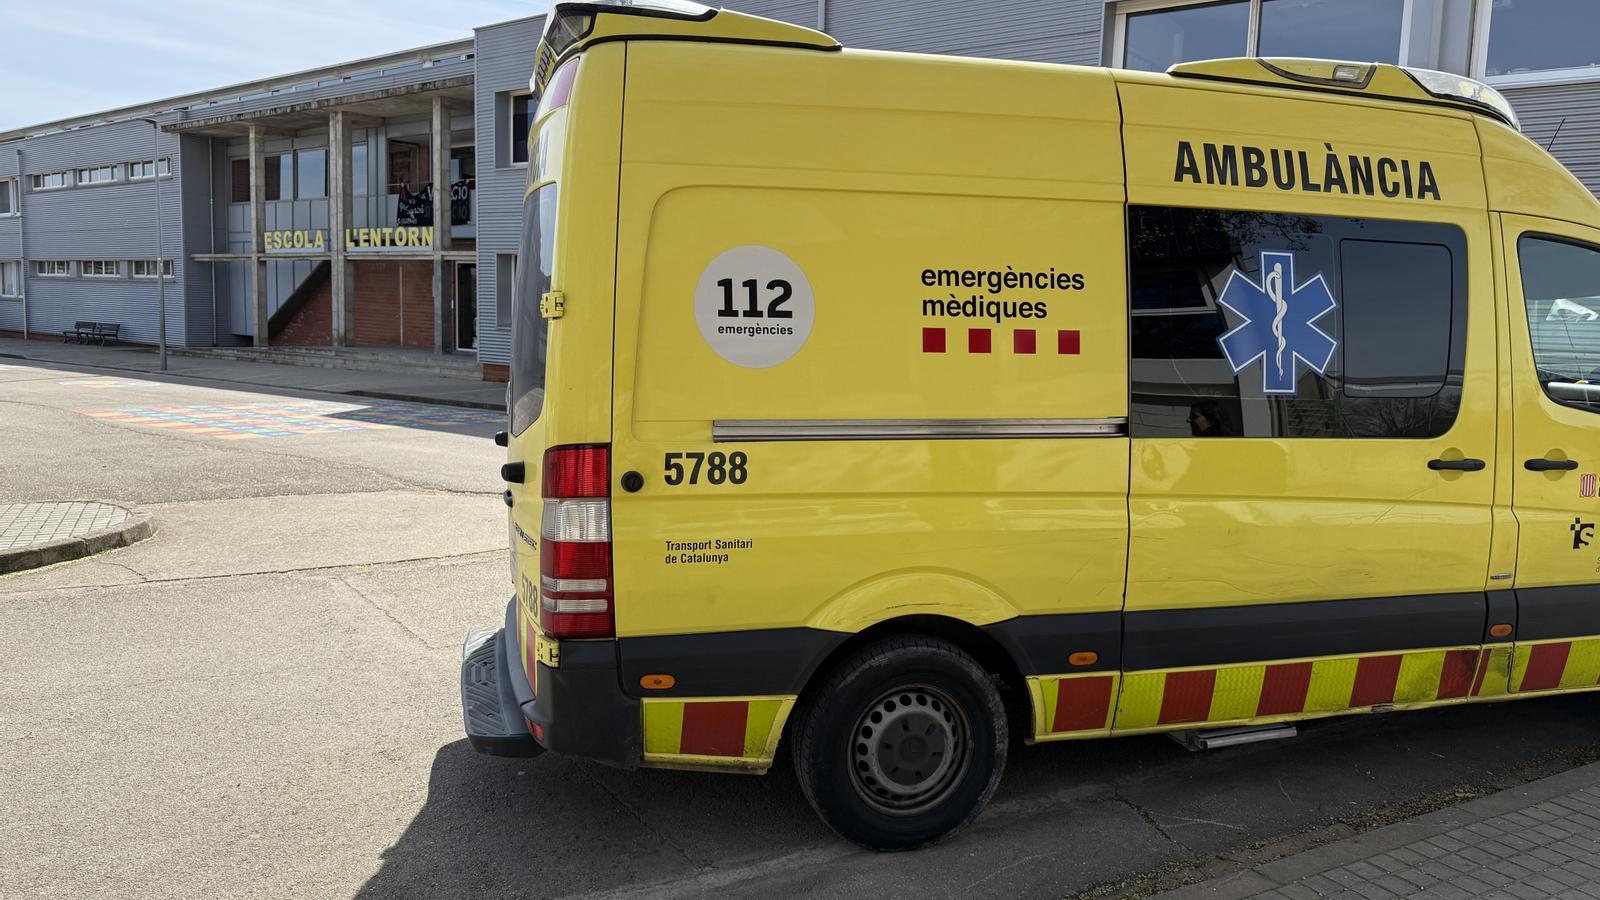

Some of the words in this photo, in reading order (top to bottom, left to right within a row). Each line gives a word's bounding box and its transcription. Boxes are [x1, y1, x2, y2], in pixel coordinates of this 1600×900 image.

[1173, 141, 1441, 201] AMBULÀNCIA
[263, 230, 325, 249] ESCOLA
[345, 226, 434, 248] L'ENTORN
[921, 266, 1085, 294] emergències
[717, 278, 793, 318] 112
[922, 294, 1048, 324] mèdiques
[718, 323, 793, 337] emergències
[664, 451, 748, 486] 5788
[665, 540, 712, 552] Transport
[715, 538, 753, 550] Sanitari
[665, 554, 677, 564] de
[680, 553, 729, 564] Catalunya
[521, 572, 538, 618] 5788
